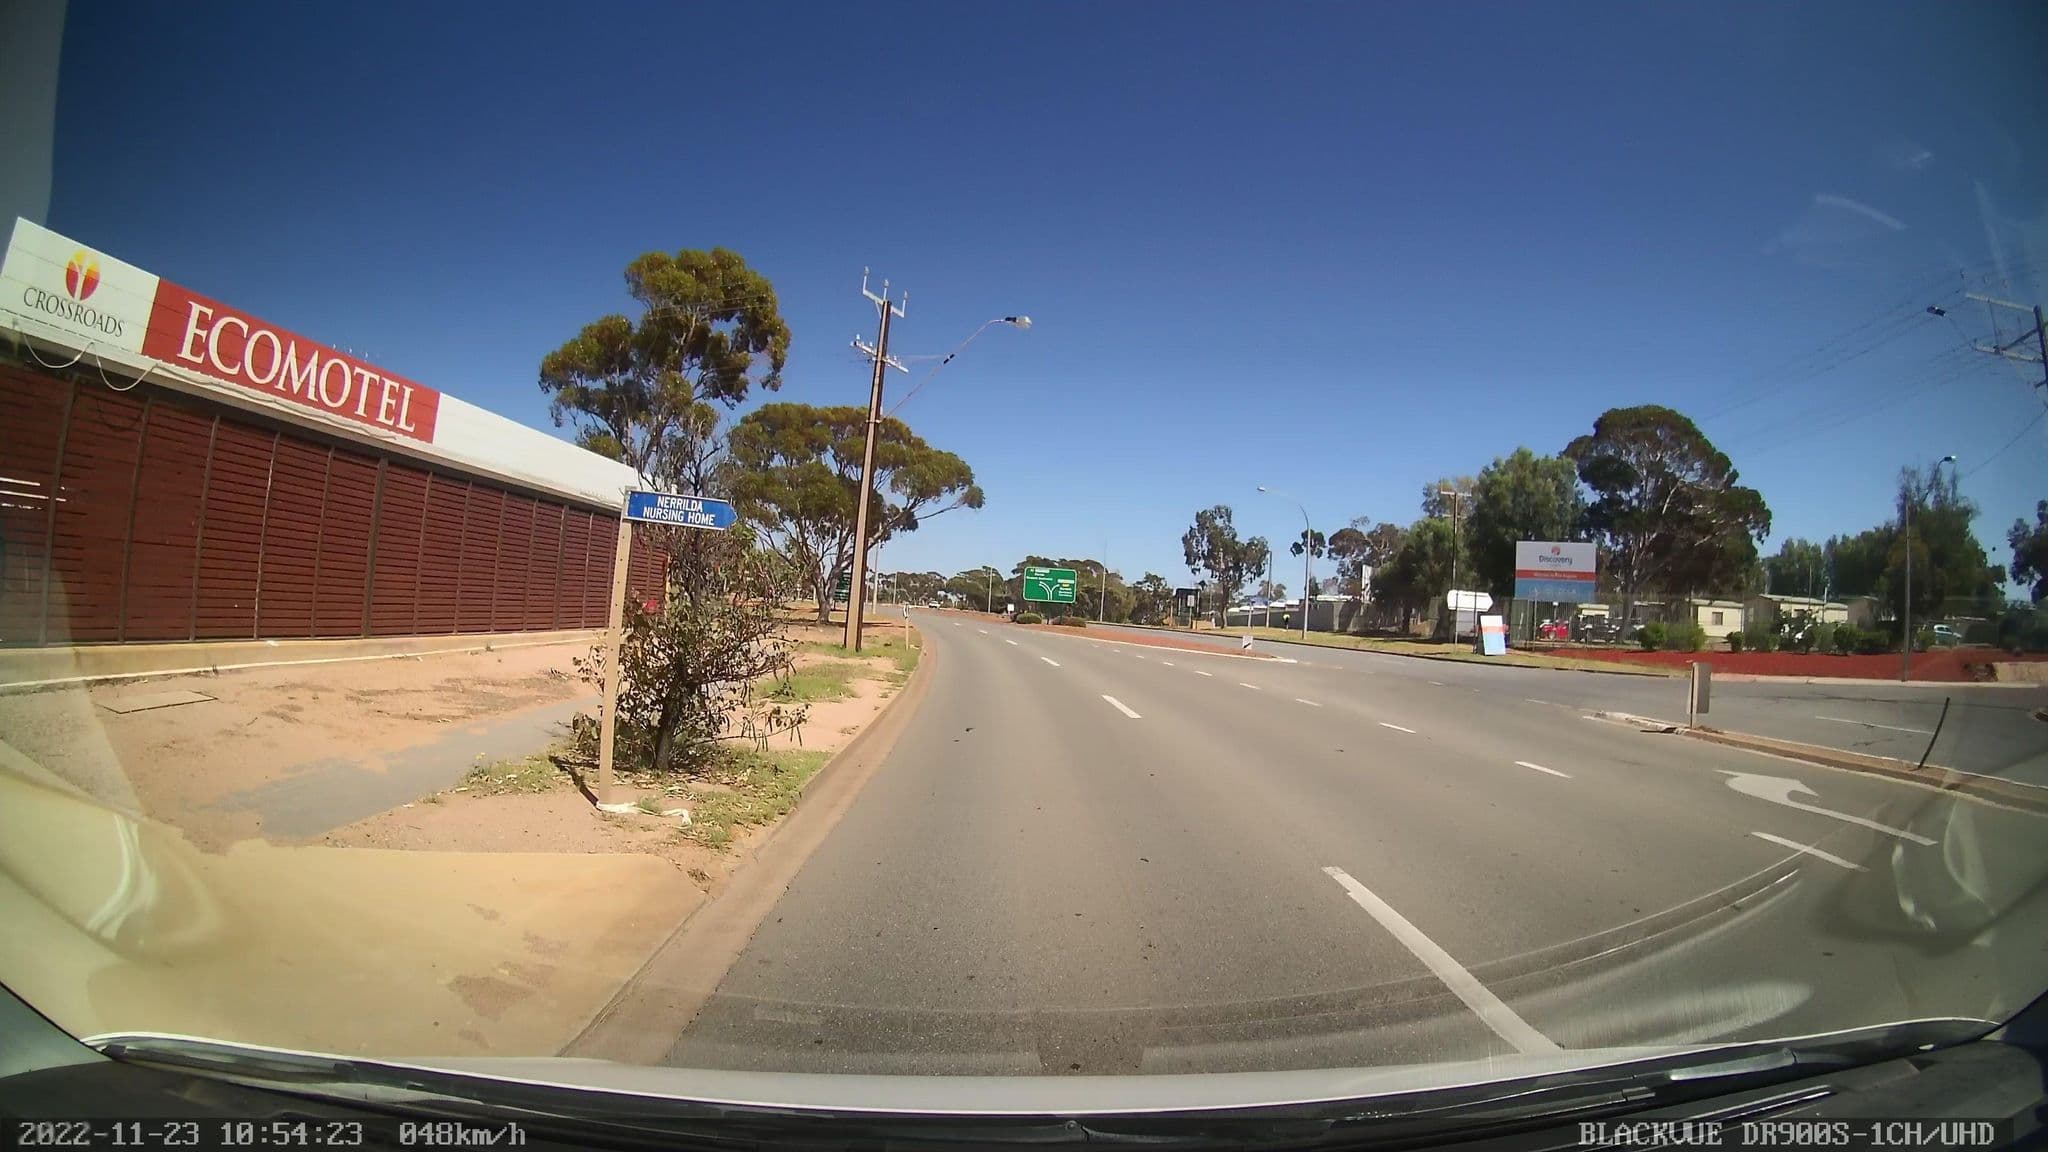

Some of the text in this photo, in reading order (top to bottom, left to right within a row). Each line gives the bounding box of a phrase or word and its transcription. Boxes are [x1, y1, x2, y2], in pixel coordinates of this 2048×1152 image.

[23, 286, 125, 338] CROSSROADS
[177, 301, 416, 432] ECOMOTEL
[657, 496, 703, 512] NERRILDA
[643, 507, 715, 526] NURSING HOME
[1538, 555, 1573, 566] Discovery
